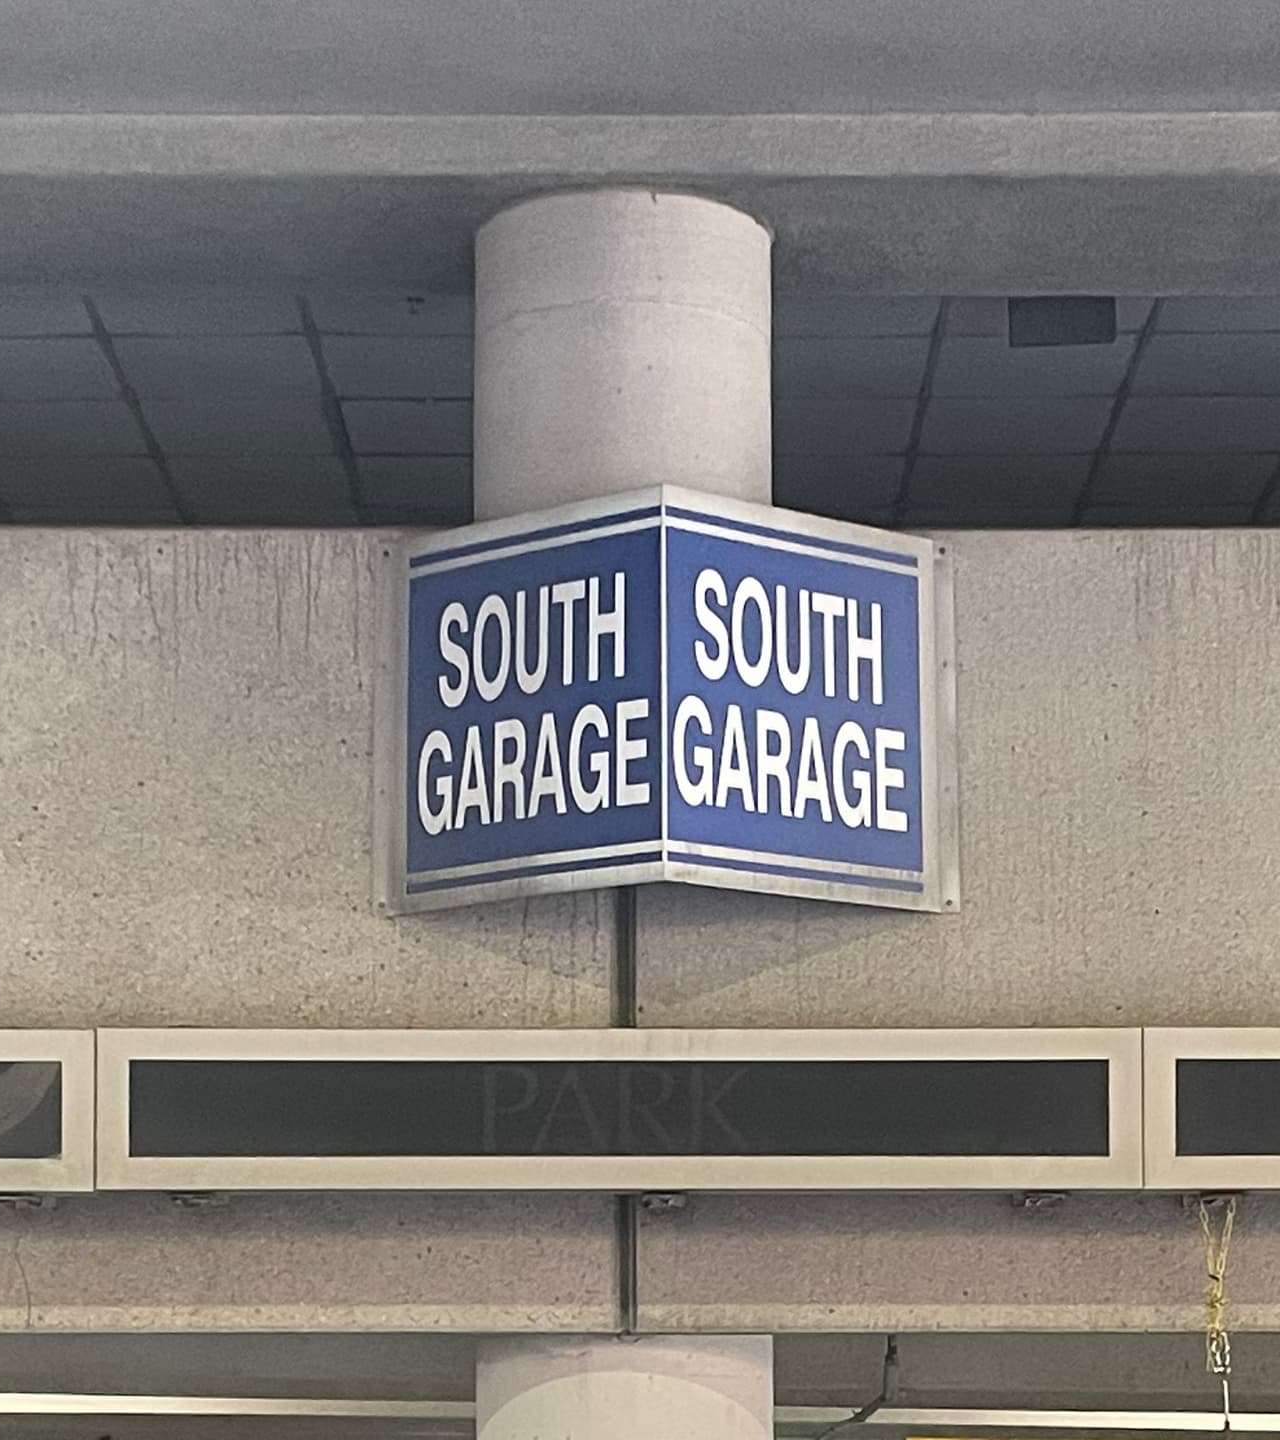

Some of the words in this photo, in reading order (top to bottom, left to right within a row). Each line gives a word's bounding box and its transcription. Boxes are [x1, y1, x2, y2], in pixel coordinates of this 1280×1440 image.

[439, 571, 625, 708] SOUTH
[693, 568, 882, 705] SOUTH
[418, 699, 650, 836] GARAGE
[672, 695, 908, 832] GARAGE
[483, 1065, 752, 1152] PARK
